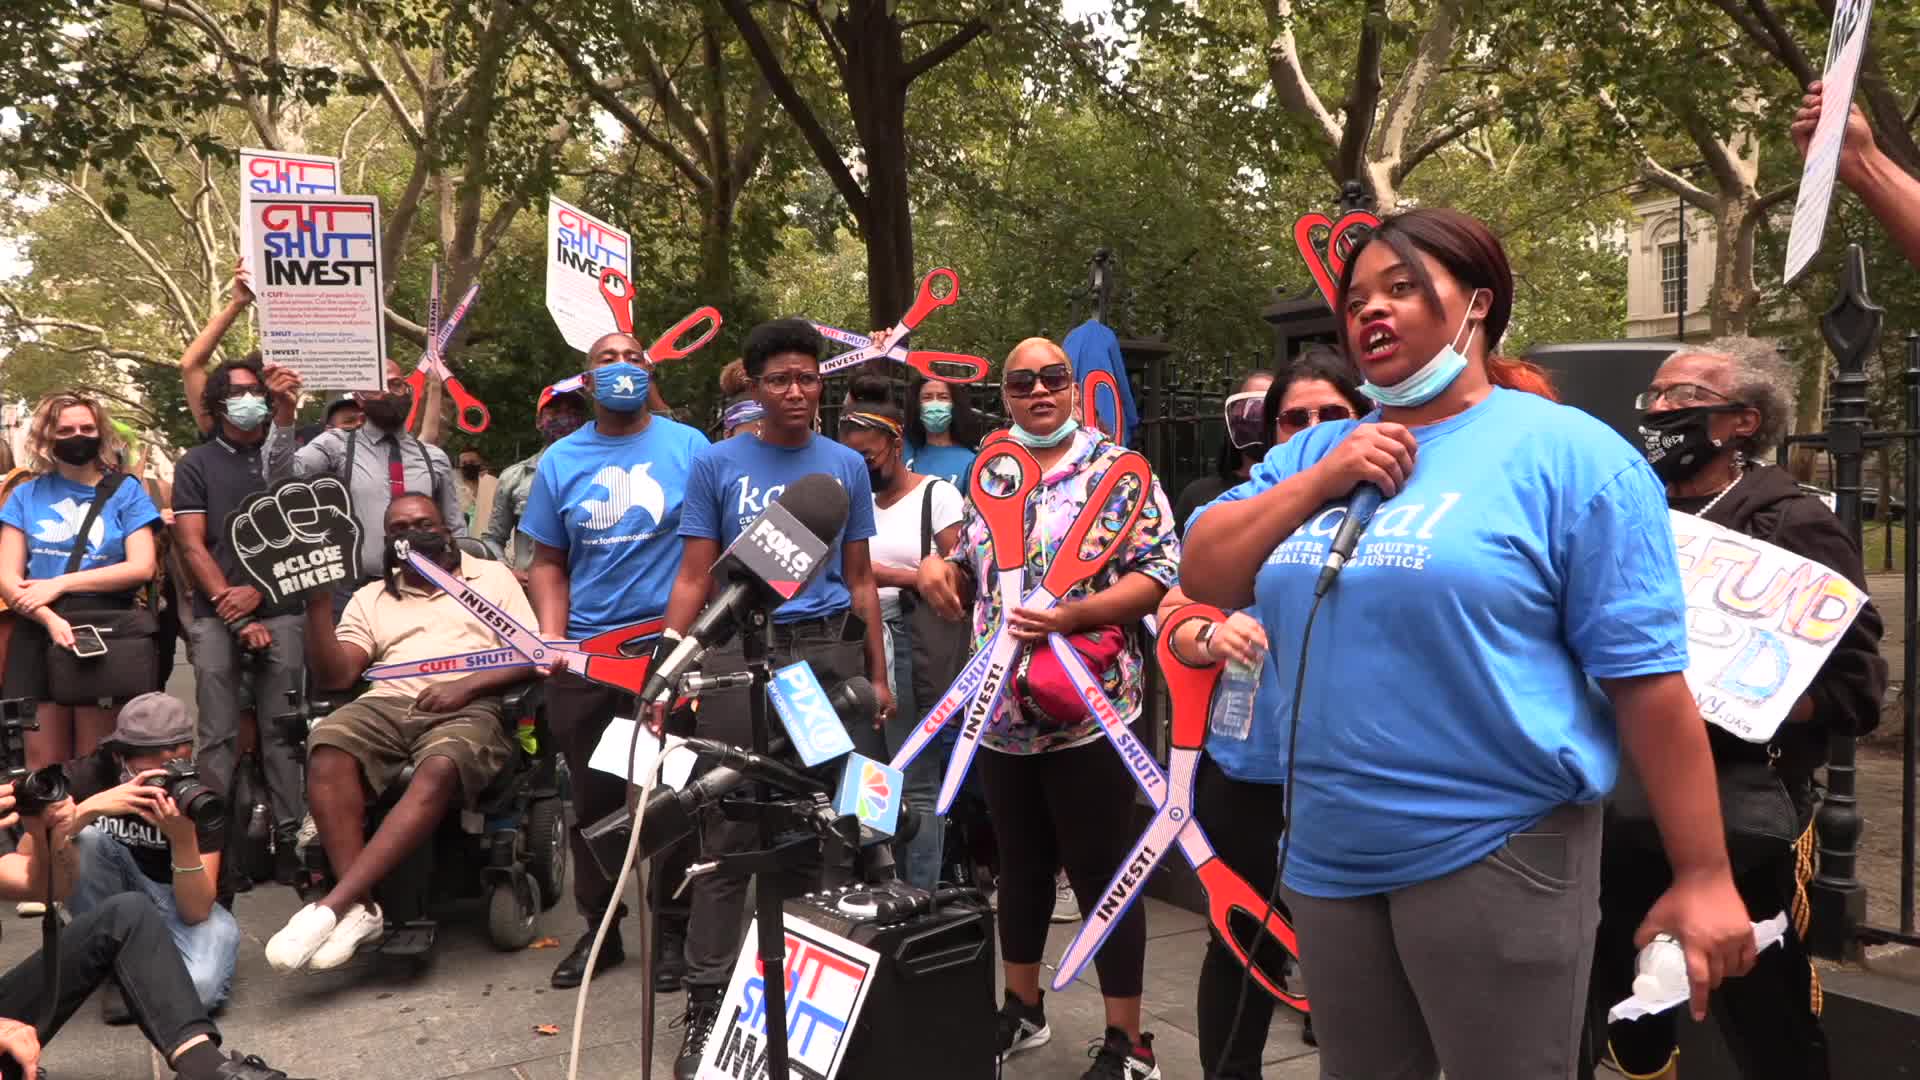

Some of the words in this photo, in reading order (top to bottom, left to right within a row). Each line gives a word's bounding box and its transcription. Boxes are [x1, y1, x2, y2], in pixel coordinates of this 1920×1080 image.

[262, 205, 371, 232] CUT
[559, 209, 627, 245] CUT
[264, 221, 371, 258] SHUT
[558, 227, 627, 266] SHUT
[264, 250, 375, 286] INVEST
[824, 352, 865, 371] INVEST!
[272, 545, 343, 578] #CLOSE
[1359, 554, 1425, 570] JUSTICE
[1366, 543, 1432, 560] EQUITY,
[1677, 536, 1863, 647] FUND
[459, 590, 517, 638] INVEST!
[418, 658, 457, 674] CUT!
[465, 651, 513, 667] SHUT!
[923, 697, 957, 735] CUT!
[963, 663, 1004, 741] INVEST!
[1085, 686, 1119, 728] CUT!
[1116, 733, 1161, 788] SHUT!
[1096, 846, 1157, 922] INVEST!
